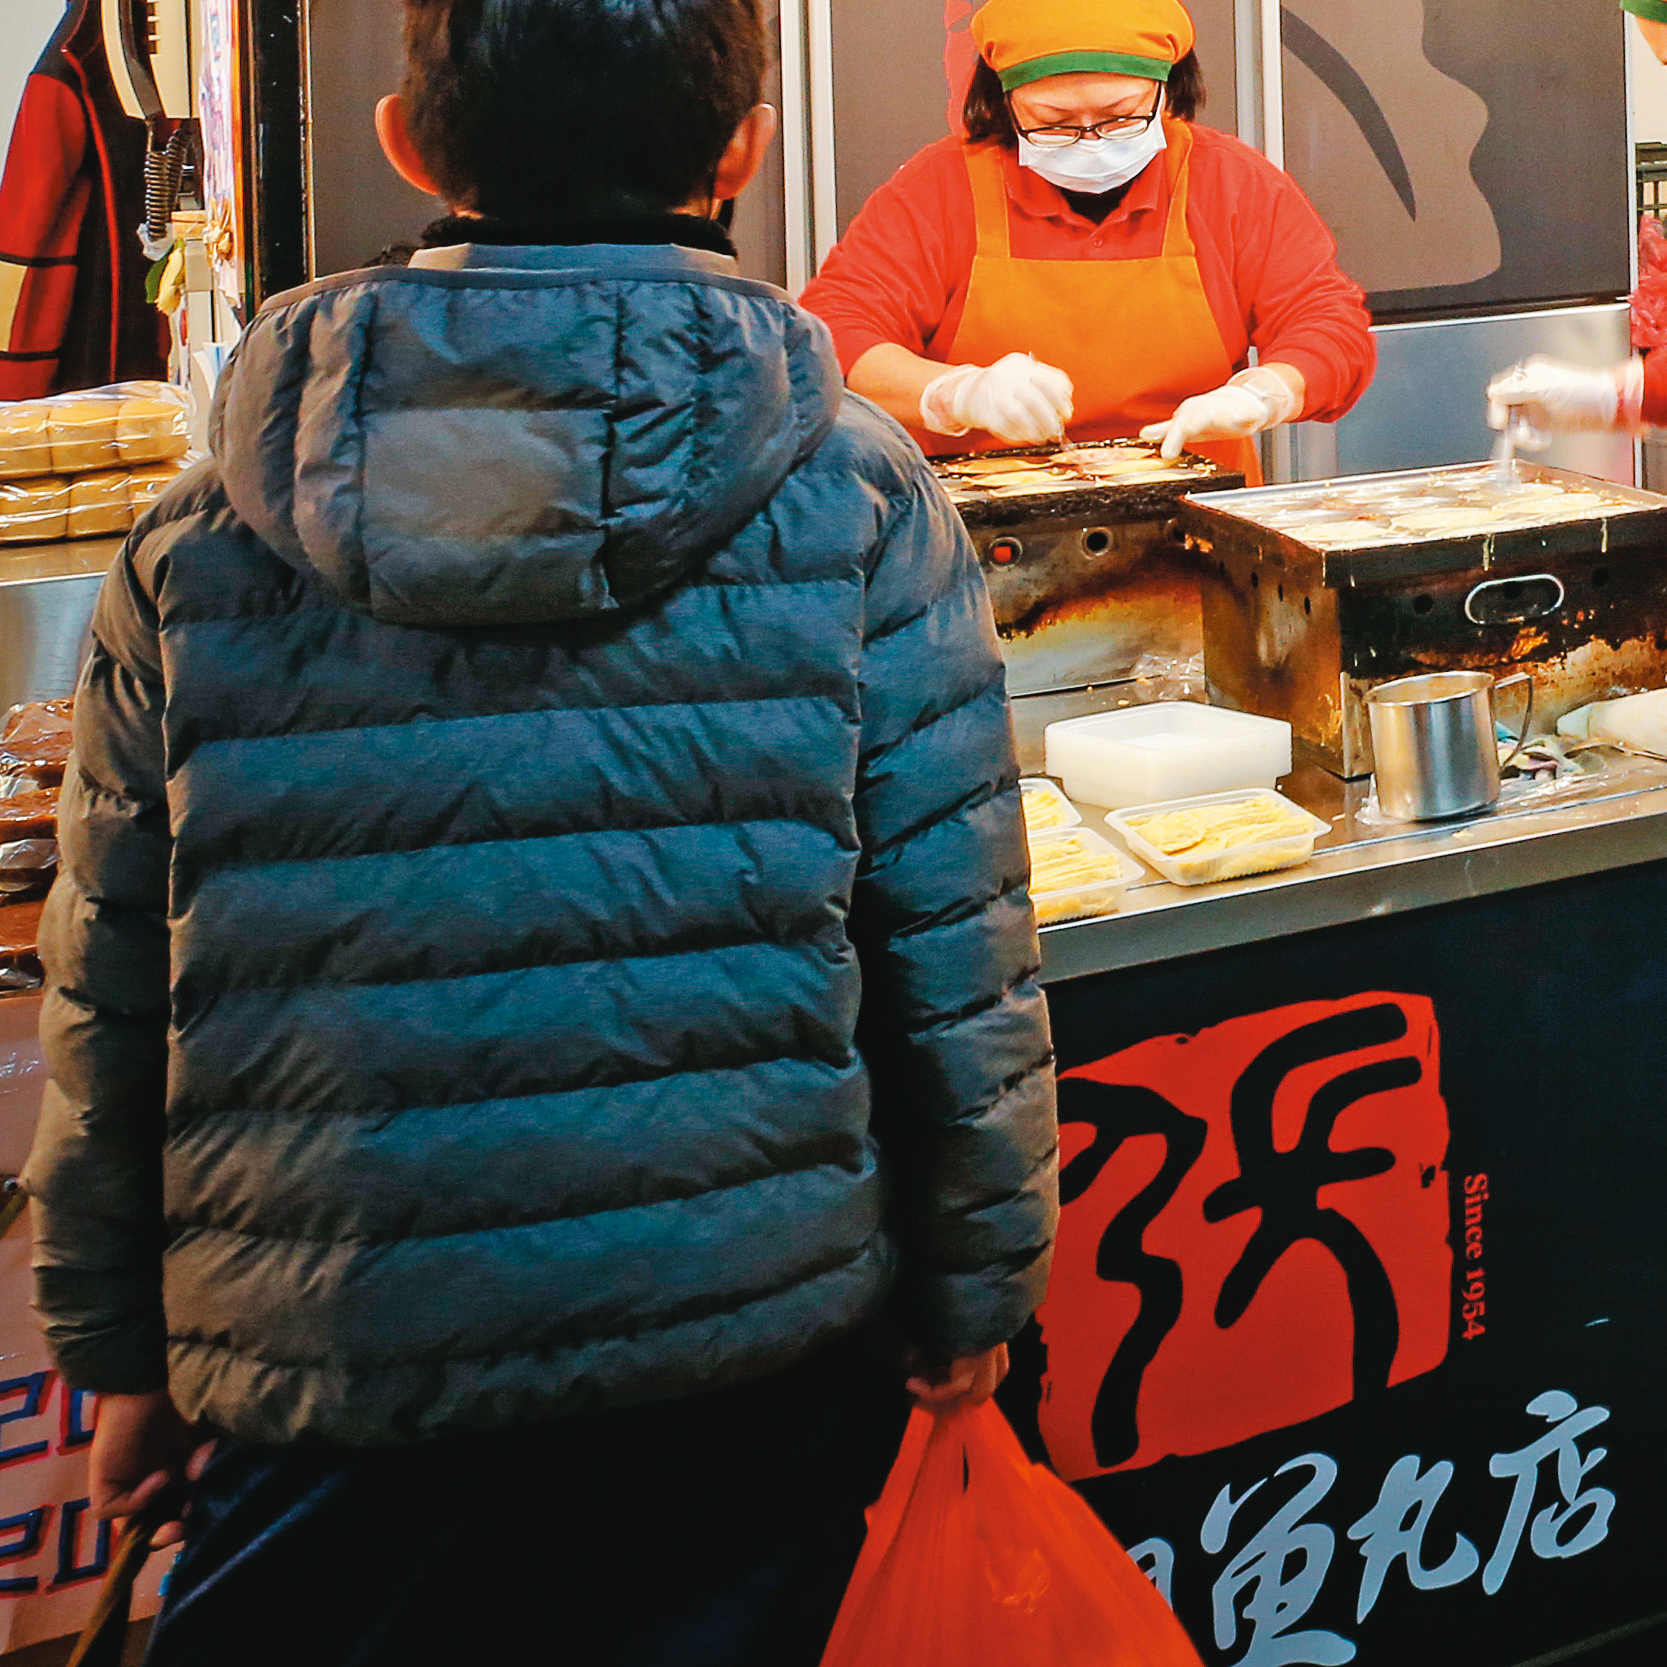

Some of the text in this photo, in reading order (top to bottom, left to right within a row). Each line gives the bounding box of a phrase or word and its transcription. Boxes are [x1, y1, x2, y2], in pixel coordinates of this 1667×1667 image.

[1462, 1172, 1489, 1340] Since 1954
[1124, 1389, 1616, 1667] 魚丸店
